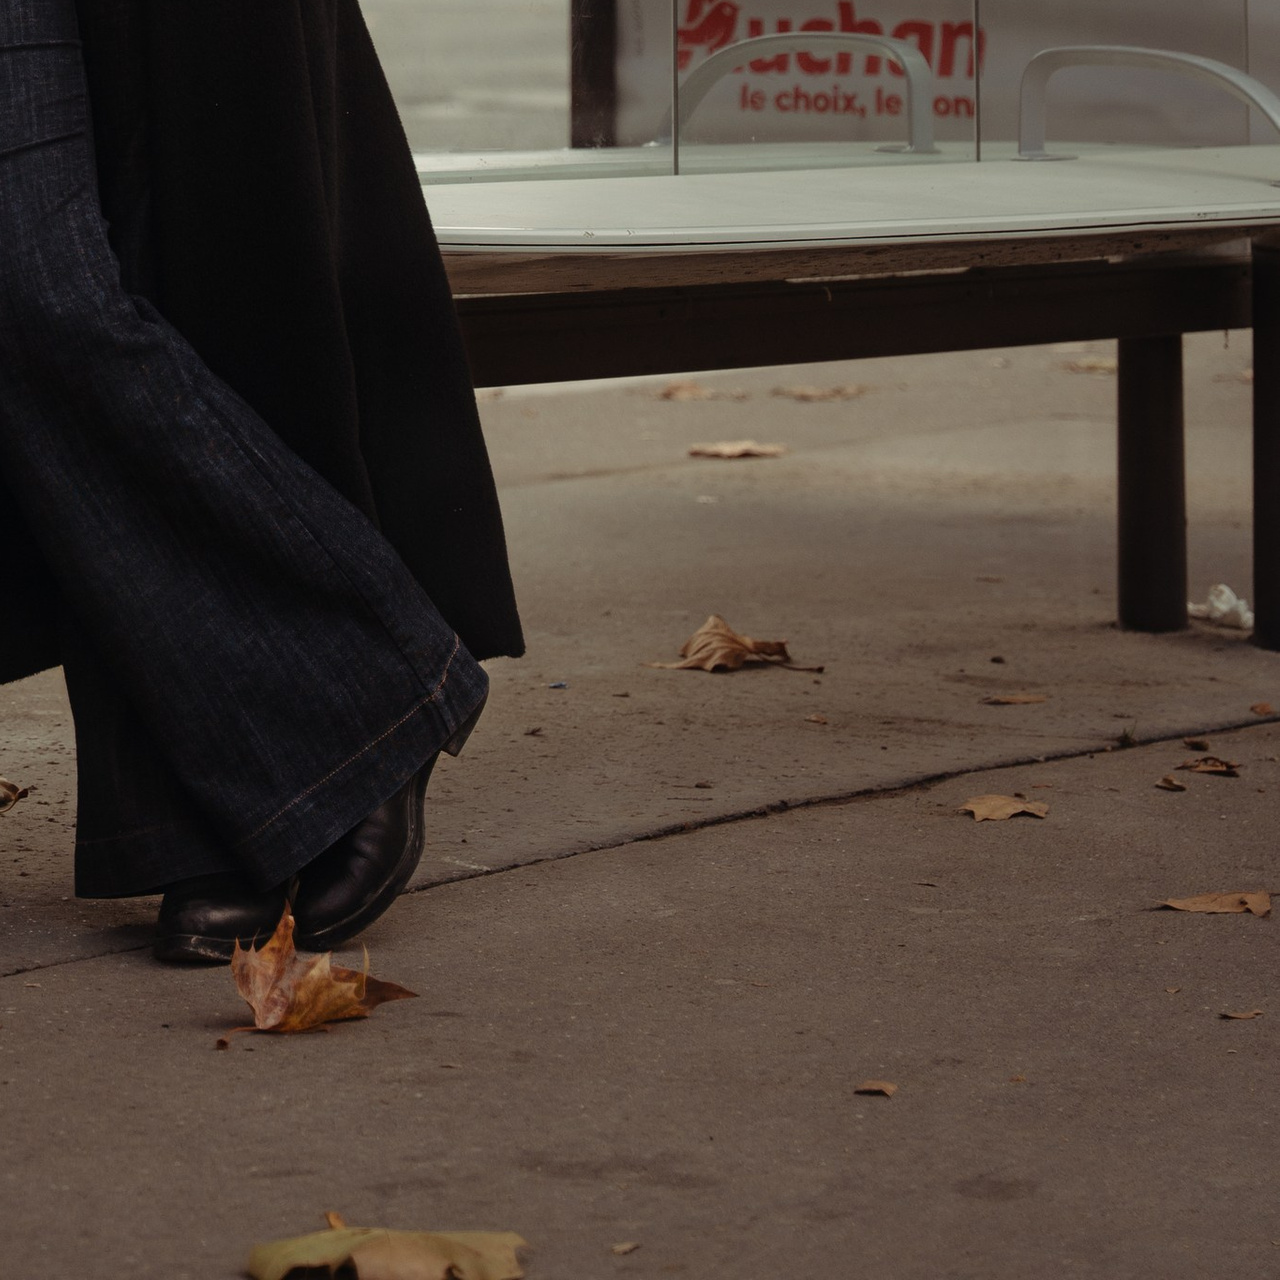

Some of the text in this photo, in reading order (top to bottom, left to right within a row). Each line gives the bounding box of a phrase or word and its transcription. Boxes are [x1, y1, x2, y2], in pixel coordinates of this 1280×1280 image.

[740, 82, 975, 118] le choix, le on
